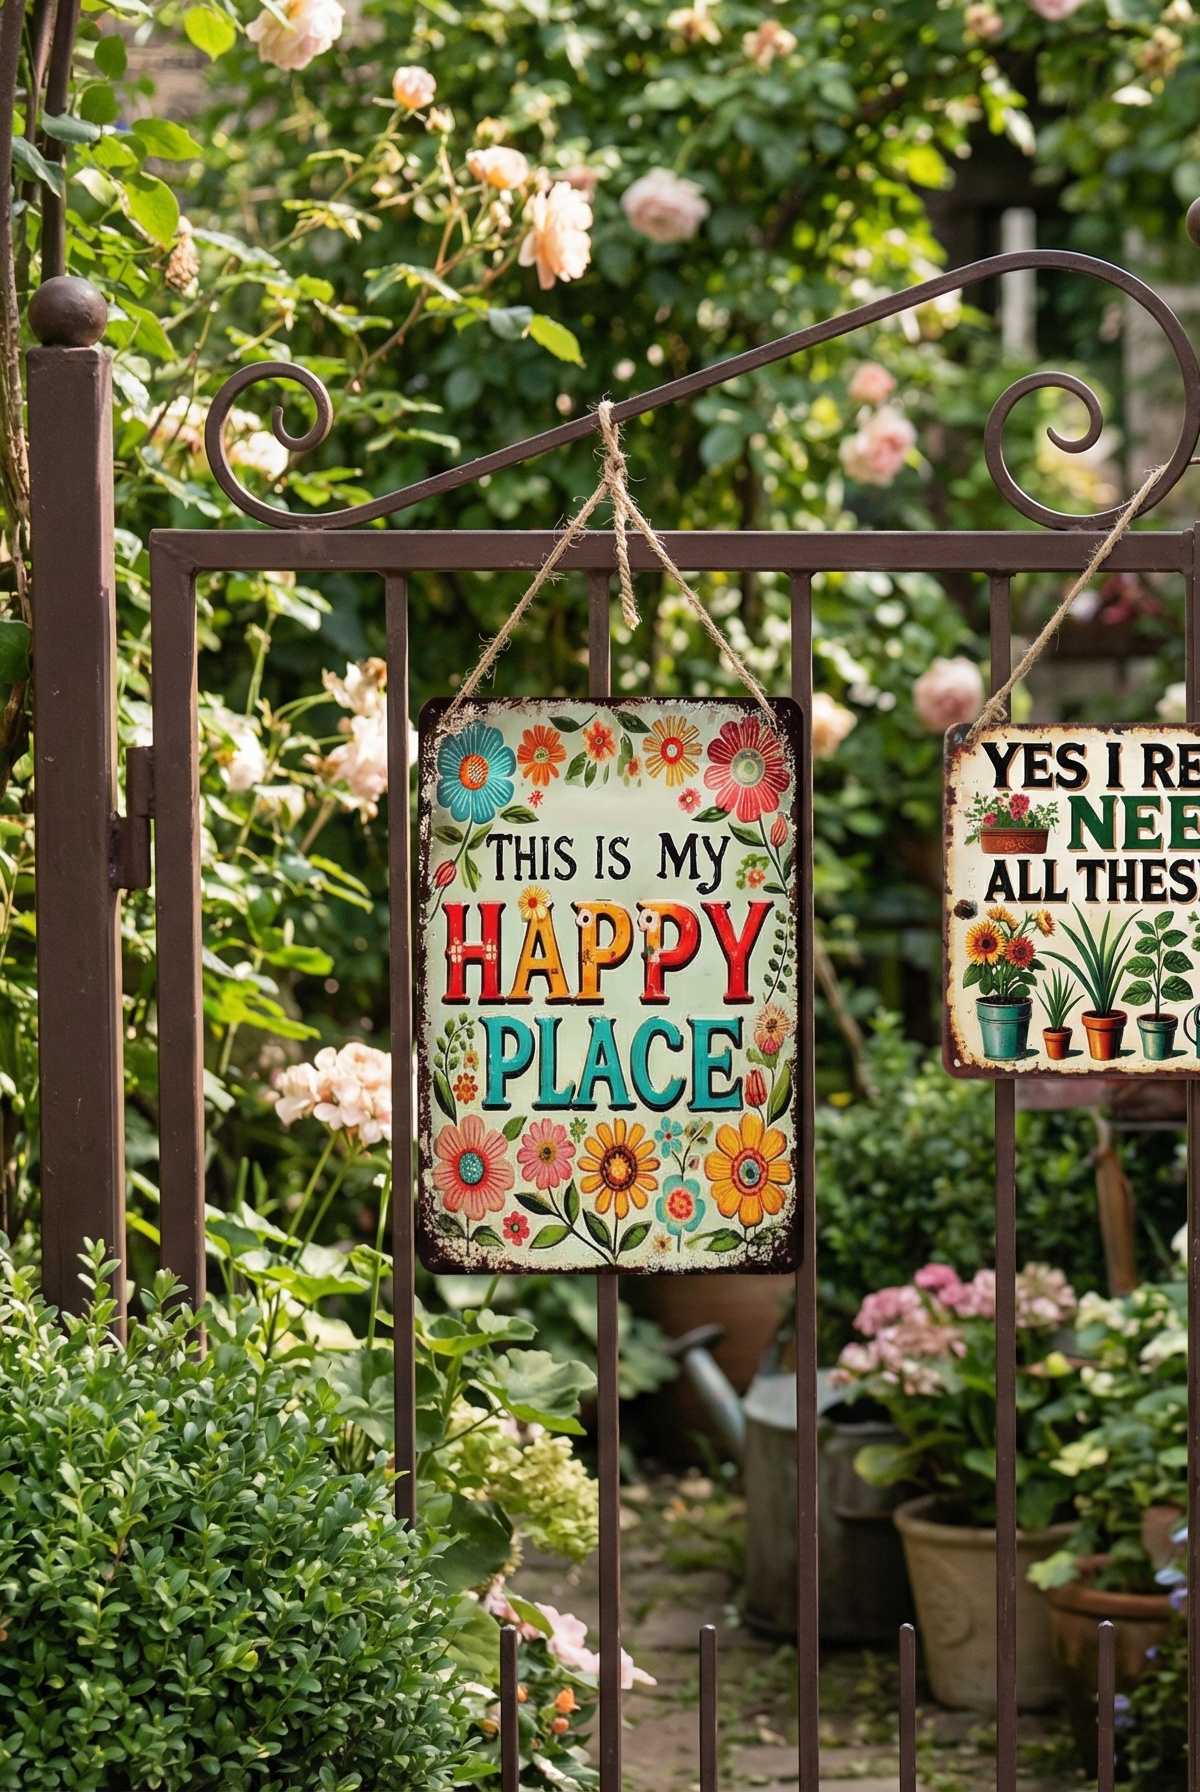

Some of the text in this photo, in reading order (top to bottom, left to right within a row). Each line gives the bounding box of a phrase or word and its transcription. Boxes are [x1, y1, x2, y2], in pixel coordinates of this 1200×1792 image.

[981, 742, 1090, 790] YES
[1106, 743, 1124, 789] I
[486, 832, 576, 881] THIS
[595, 836, 631, 880] IS
[983, 859, 1068, 904] ALL
[441, 900, 774, 1006] HAPPY
[477, 1015, 745, 1112] PLACE
